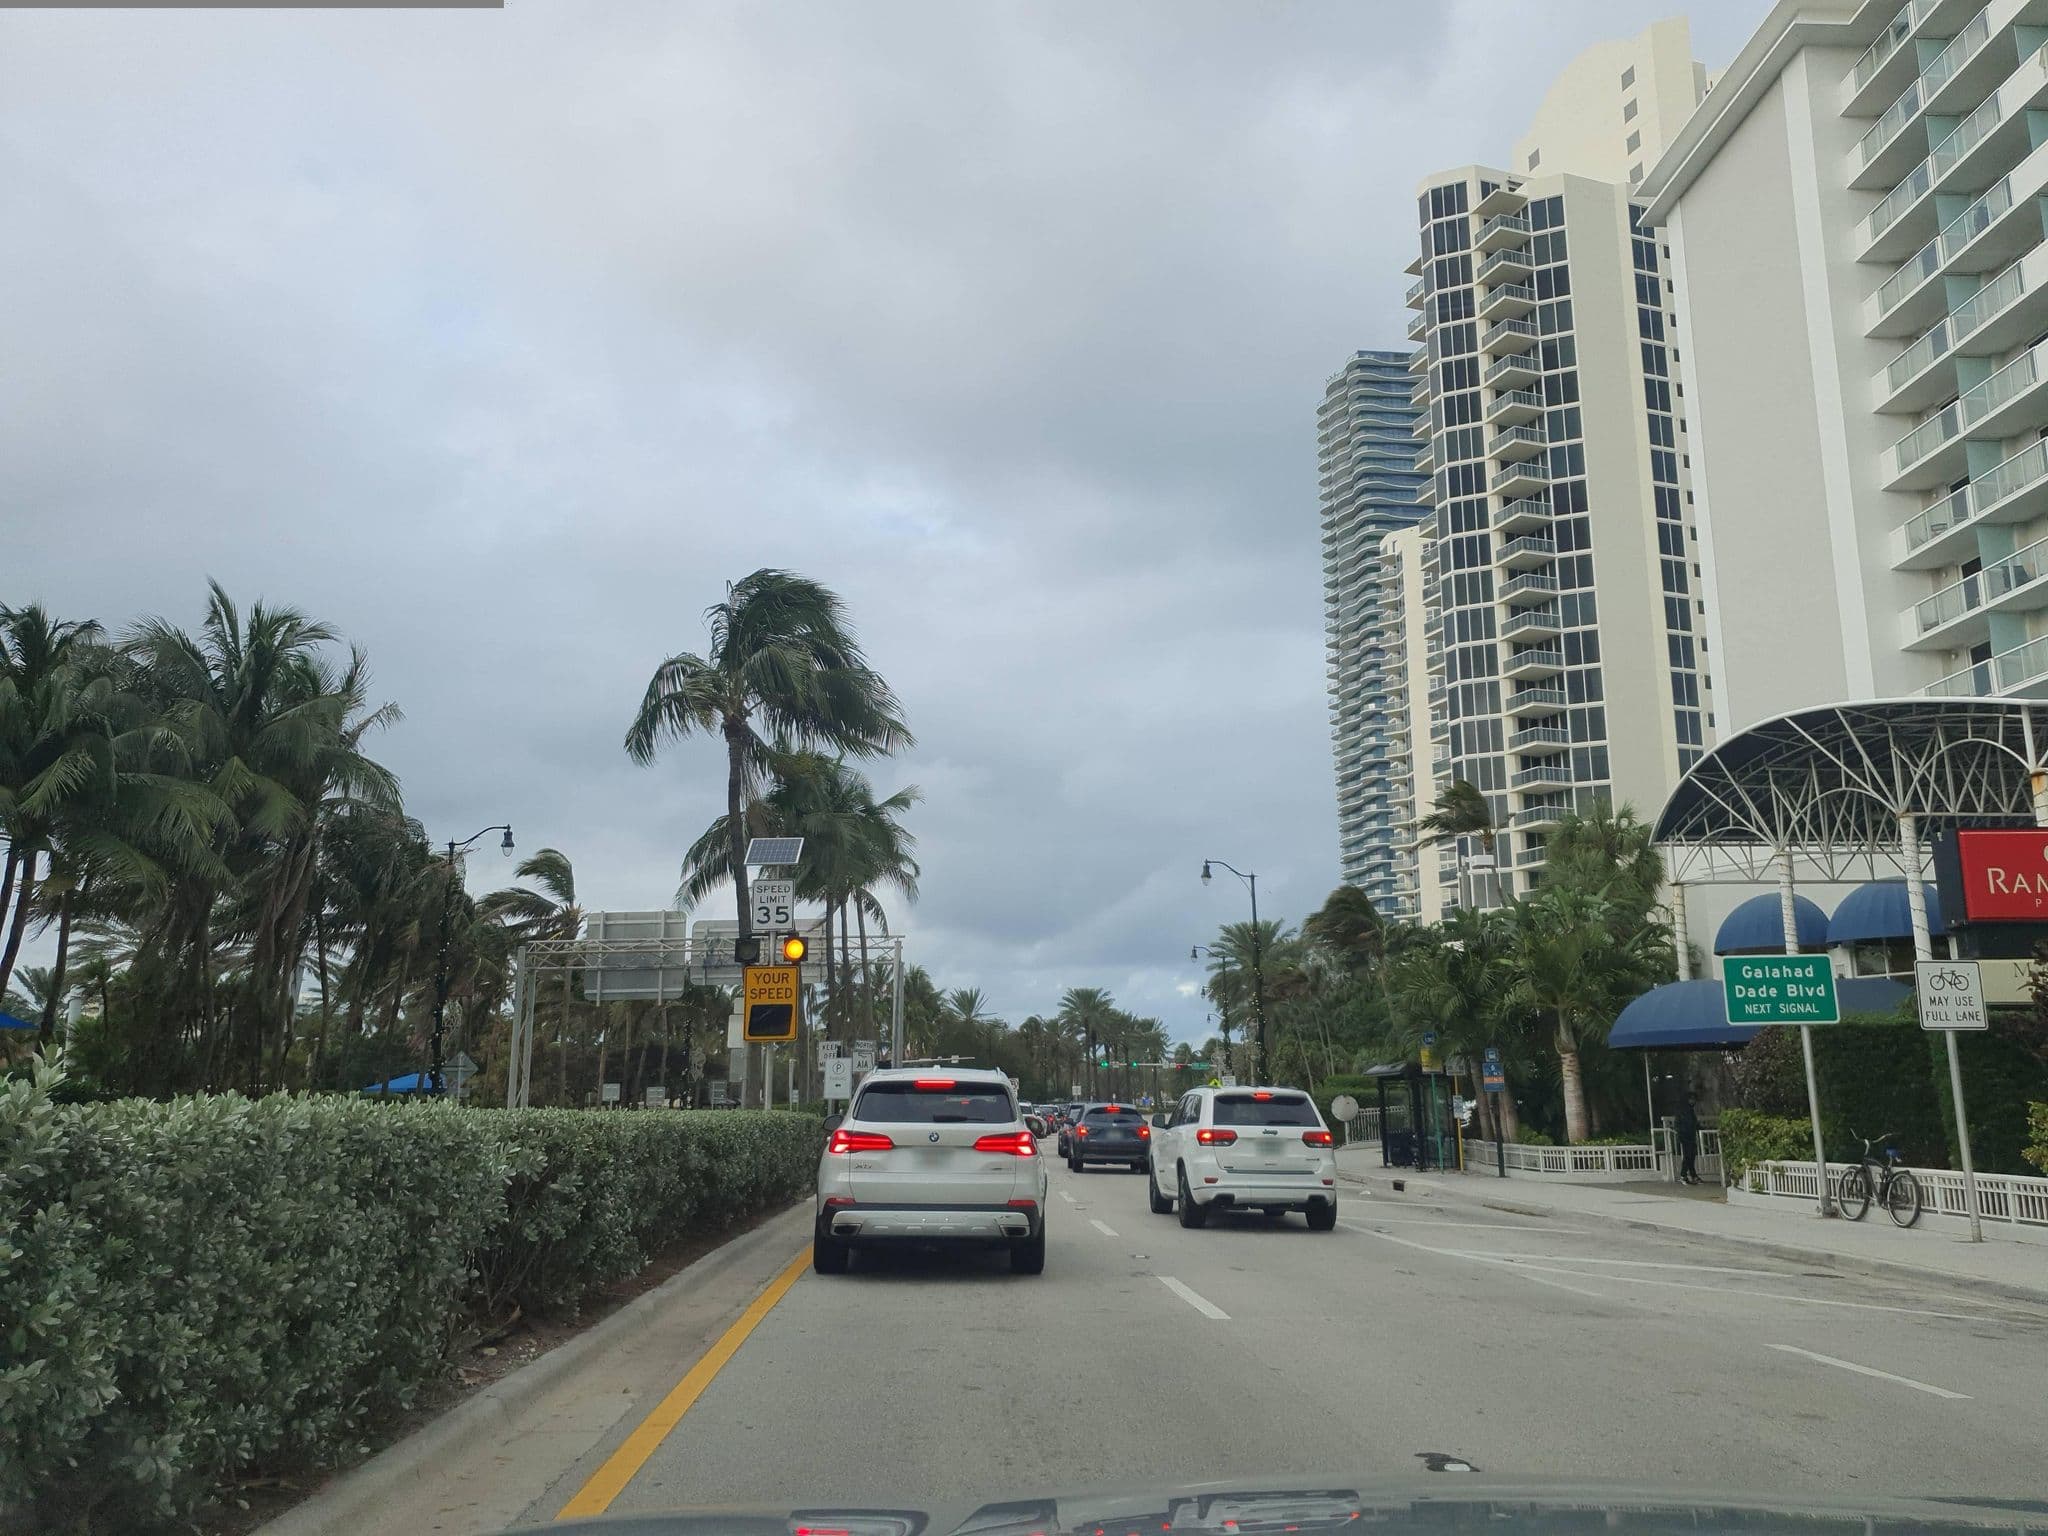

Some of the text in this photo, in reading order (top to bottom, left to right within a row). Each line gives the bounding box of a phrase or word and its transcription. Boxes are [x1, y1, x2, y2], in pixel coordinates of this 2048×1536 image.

[756, 885, 791, 894] SPEED
[760, 895, 786, 904] LIMIT
[757, 906, 789, 924] 35
[1742, 964, 1815, 979] Galahad
[754, 972, 789, 985] YOUR
[750, 987, 793, 1000] SPEED
[1734, 983, 1826, 998] Dade Blvd
[1929, 995, 1974, 1007] MAY USE
[1744, 1002, 1820, 1014] NEXT SIGNAL
[1925, 1010, 1982, 1021] FULL LANE
